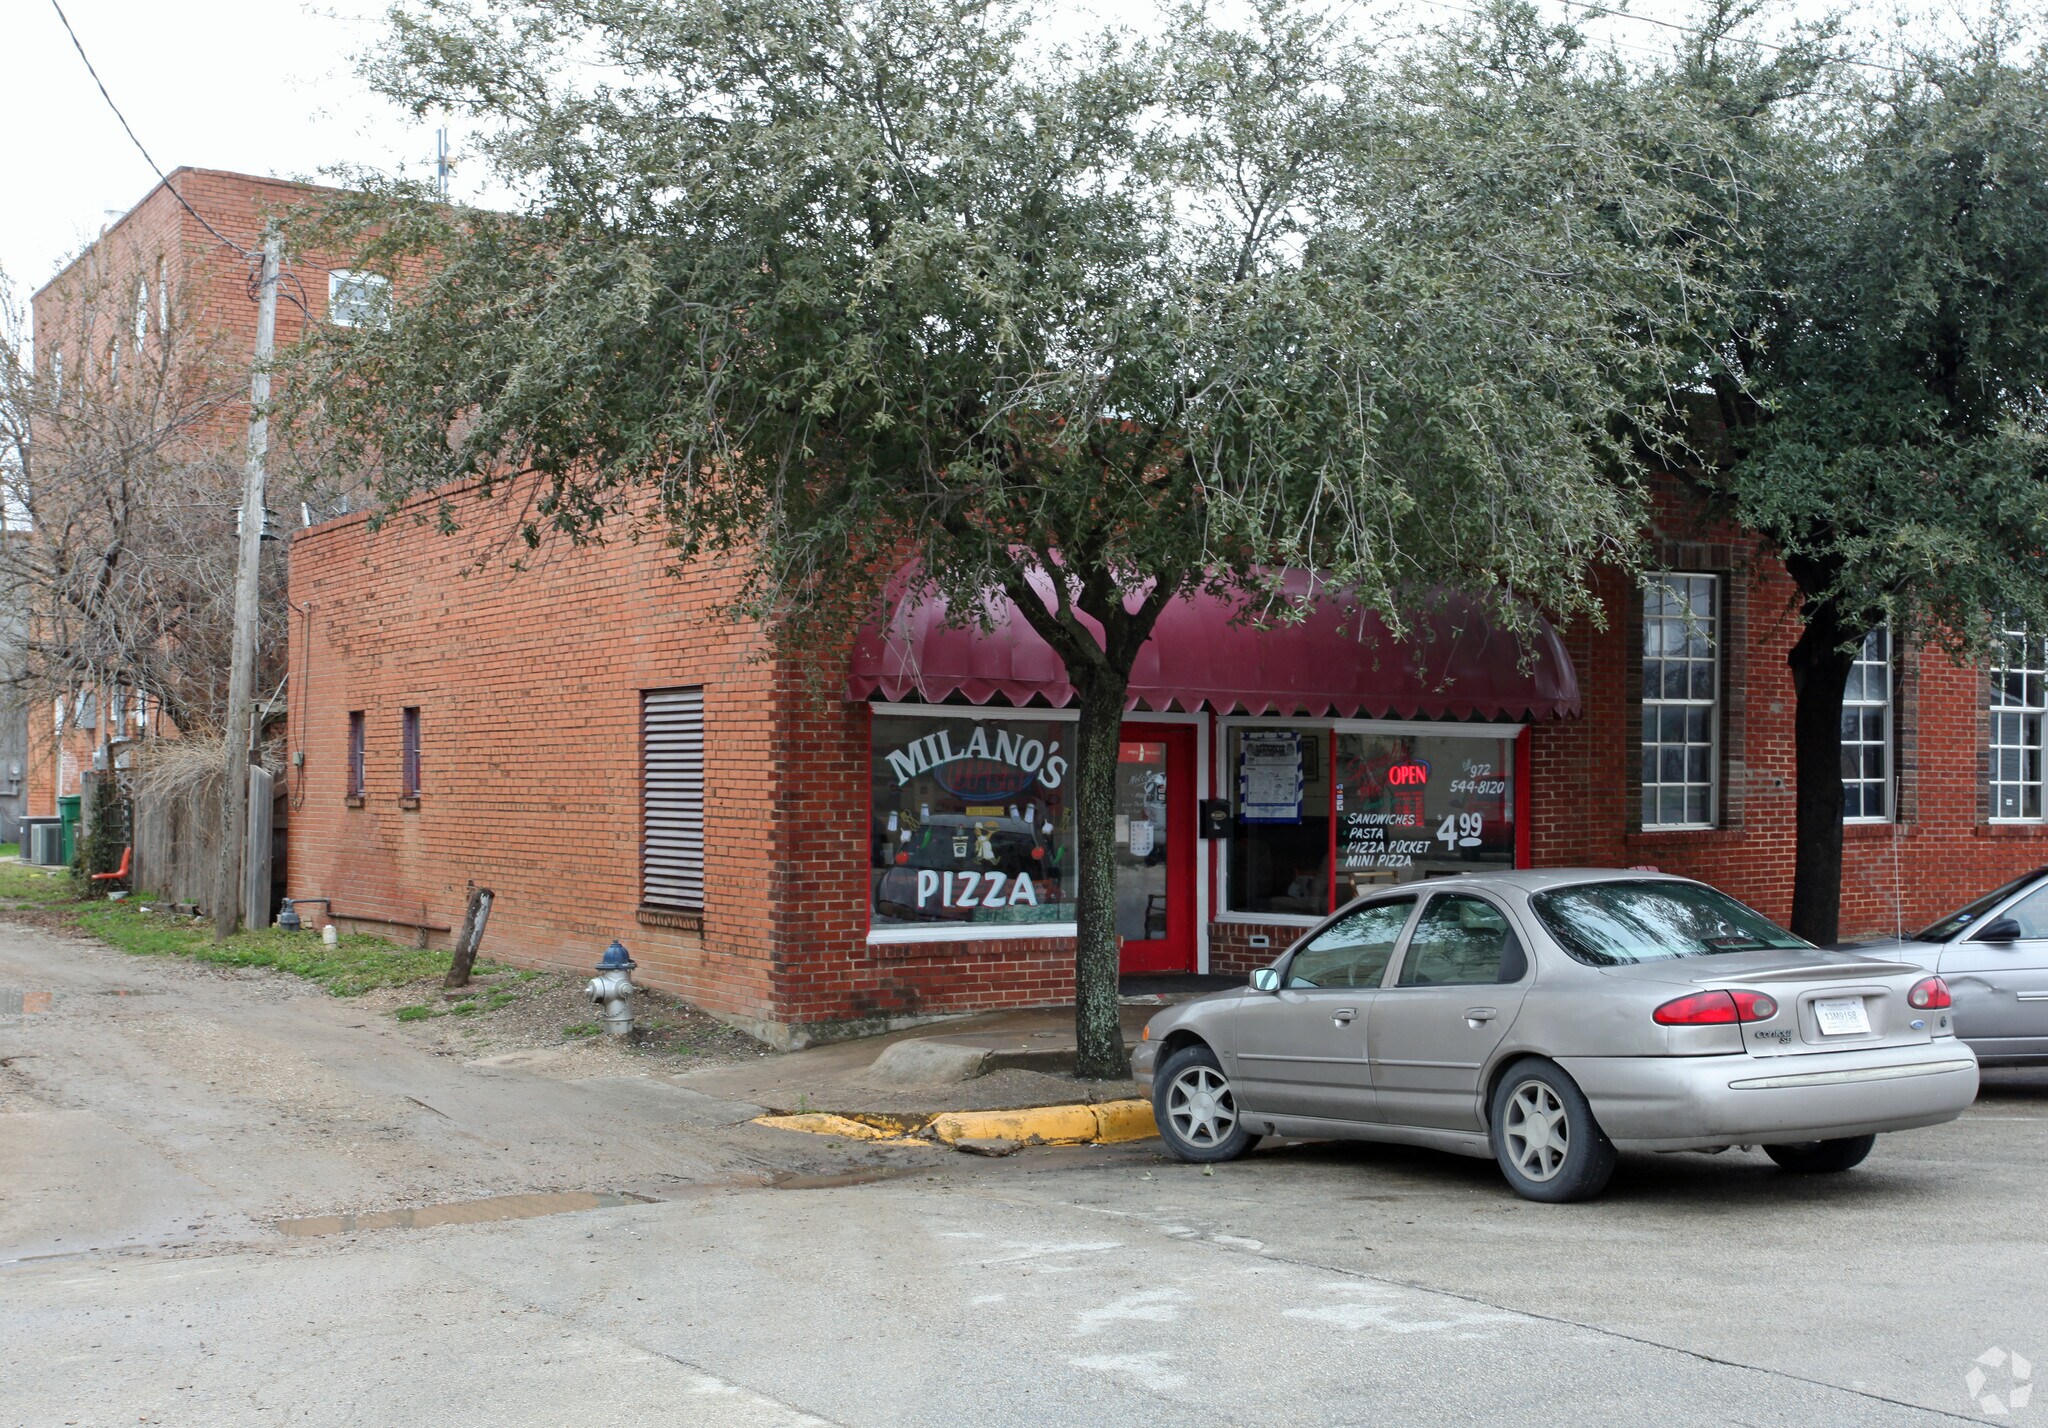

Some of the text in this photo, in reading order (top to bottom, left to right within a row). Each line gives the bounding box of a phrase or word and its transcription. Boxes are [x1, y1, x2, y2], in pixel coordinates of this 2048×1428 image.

[885, 726, 1068, 789] MILANO'S
[1389, 766, 1427, 785] OPEN
[1470, 764, 1491, 778] 972
[1450, 780, 1505, 795] 544-8120
[1347, 813, 1415, 826] SANDWICHES
[1349, 828, 1384, 839] PASTA
[1346, 840, 1431, 853] PIZZA POCKET
[1345, 854, 1412, 867] MINI PIZZA
[916, 869, 1038, 908] PIZZA
